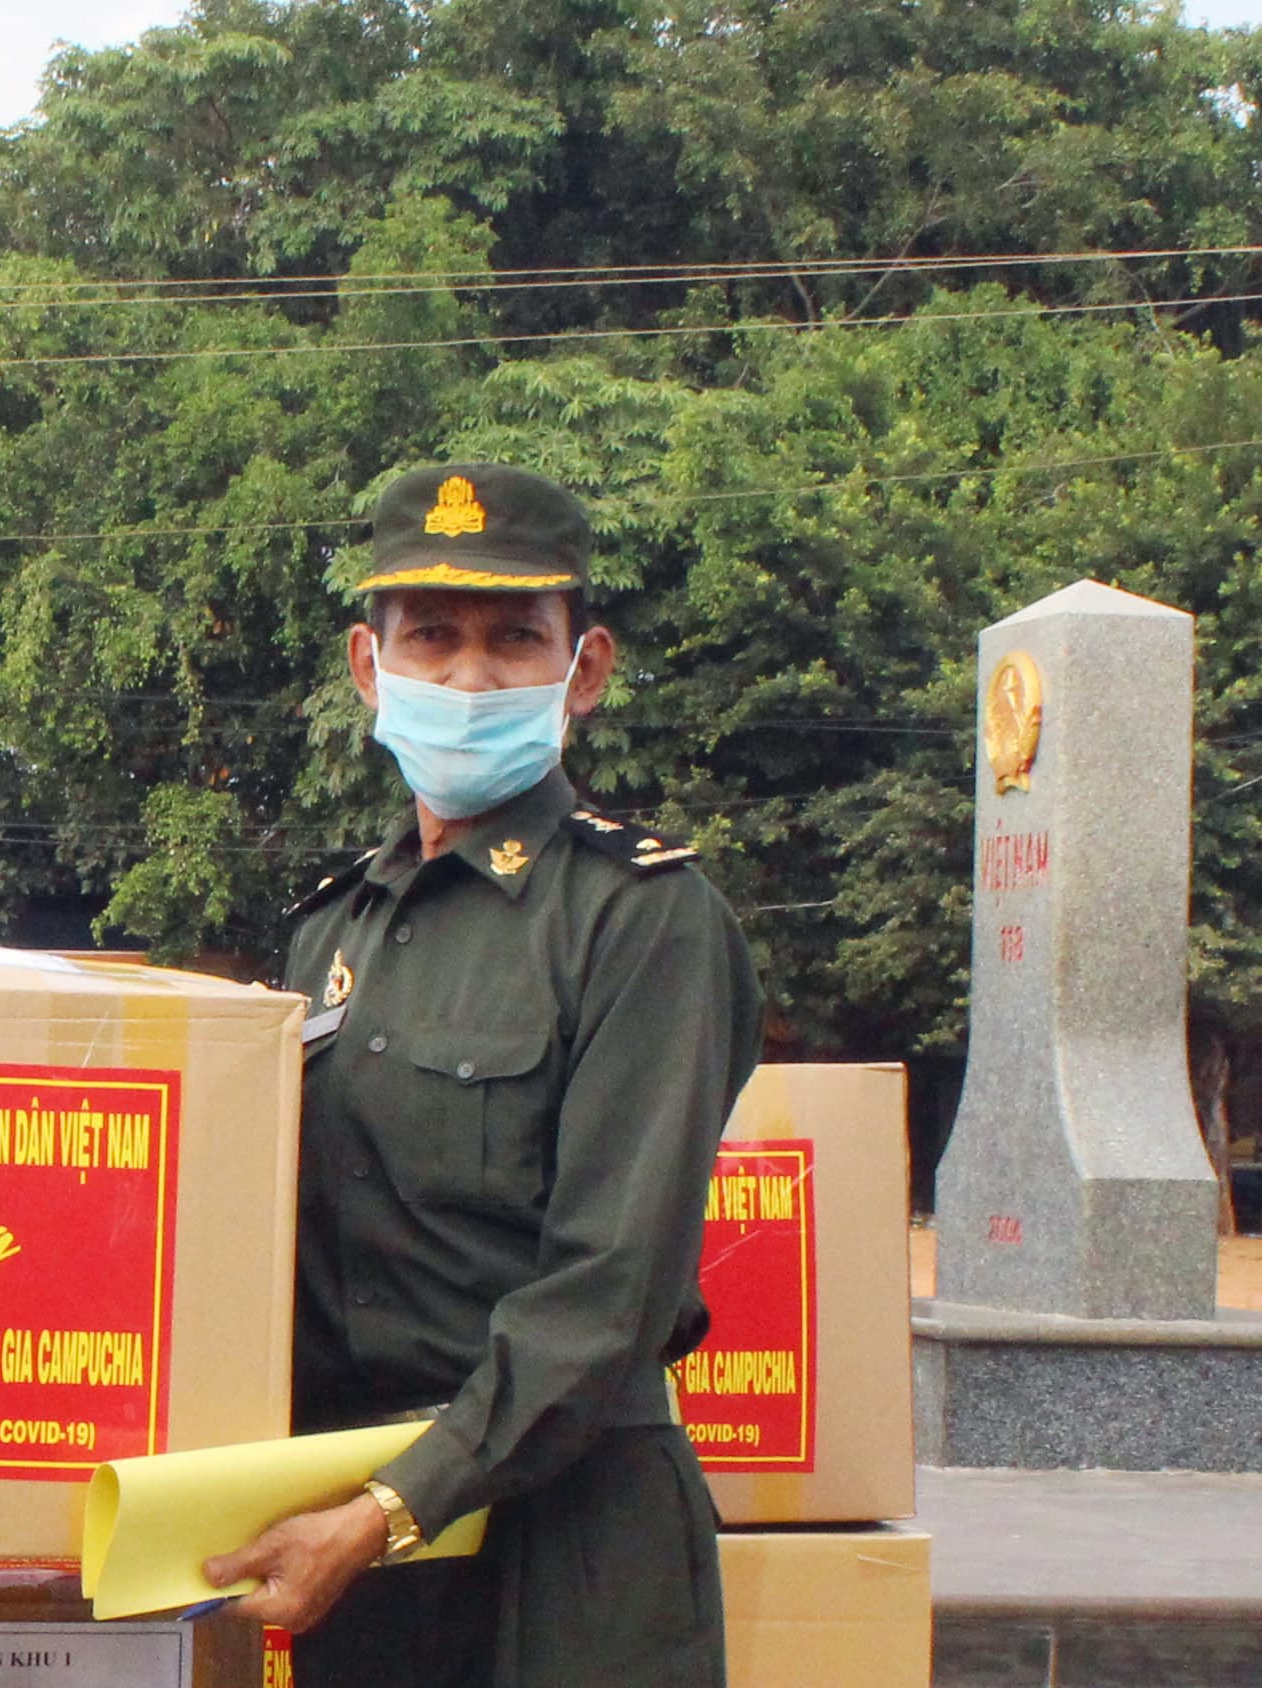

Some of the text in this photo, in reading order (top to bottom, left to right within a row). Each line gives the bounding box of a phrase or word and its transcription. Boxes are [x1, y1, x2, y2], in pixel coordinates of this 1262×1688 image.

[14, 1096, 54, 1166] DÂN
[59, 1098, 104, 1184] VIỆT
[106, 1112, 150, 1169] NAM
[721, 1165, 756, 1234] VIỆT
[759, 1175, 793, 1220] NAM
[1, 1328, 33, 1383] GIA
[37, 1329, 143, 1386] CAMPUCHIA
[685, 1351, 711, 1394] GIA
[714, 1350, 797, 1395] CAMPUCHIA
[686, 1423, 760, 1447] COVID-19)
[10, 1651, 57, 1667] KHU
